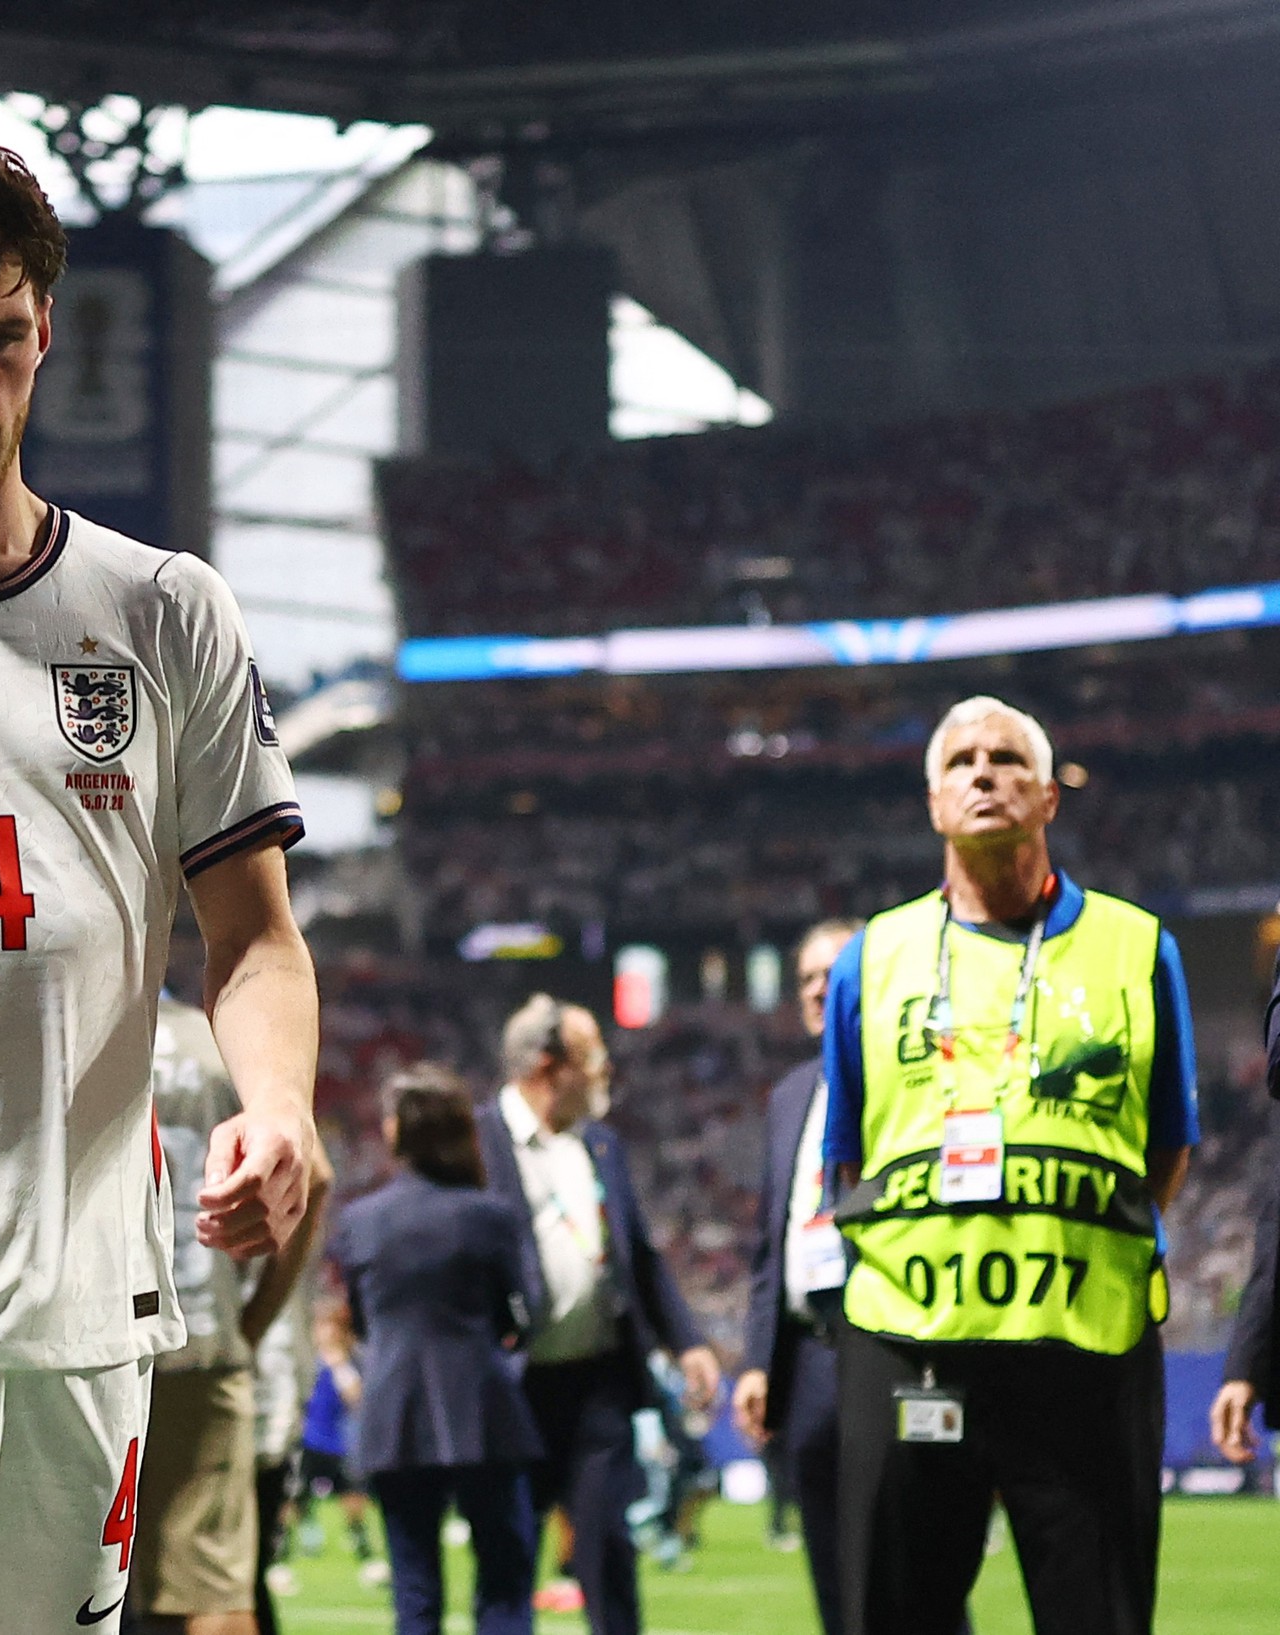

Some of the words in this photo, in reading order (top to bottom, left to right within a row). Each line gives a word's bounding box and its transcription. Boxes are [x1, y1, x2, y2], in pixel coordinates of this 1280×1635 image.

[873, 1156, 1116, 1215] SECRITY
[905, 1251, 1088, 1309] 01077
[102, 1436, 138, 1573] 4
